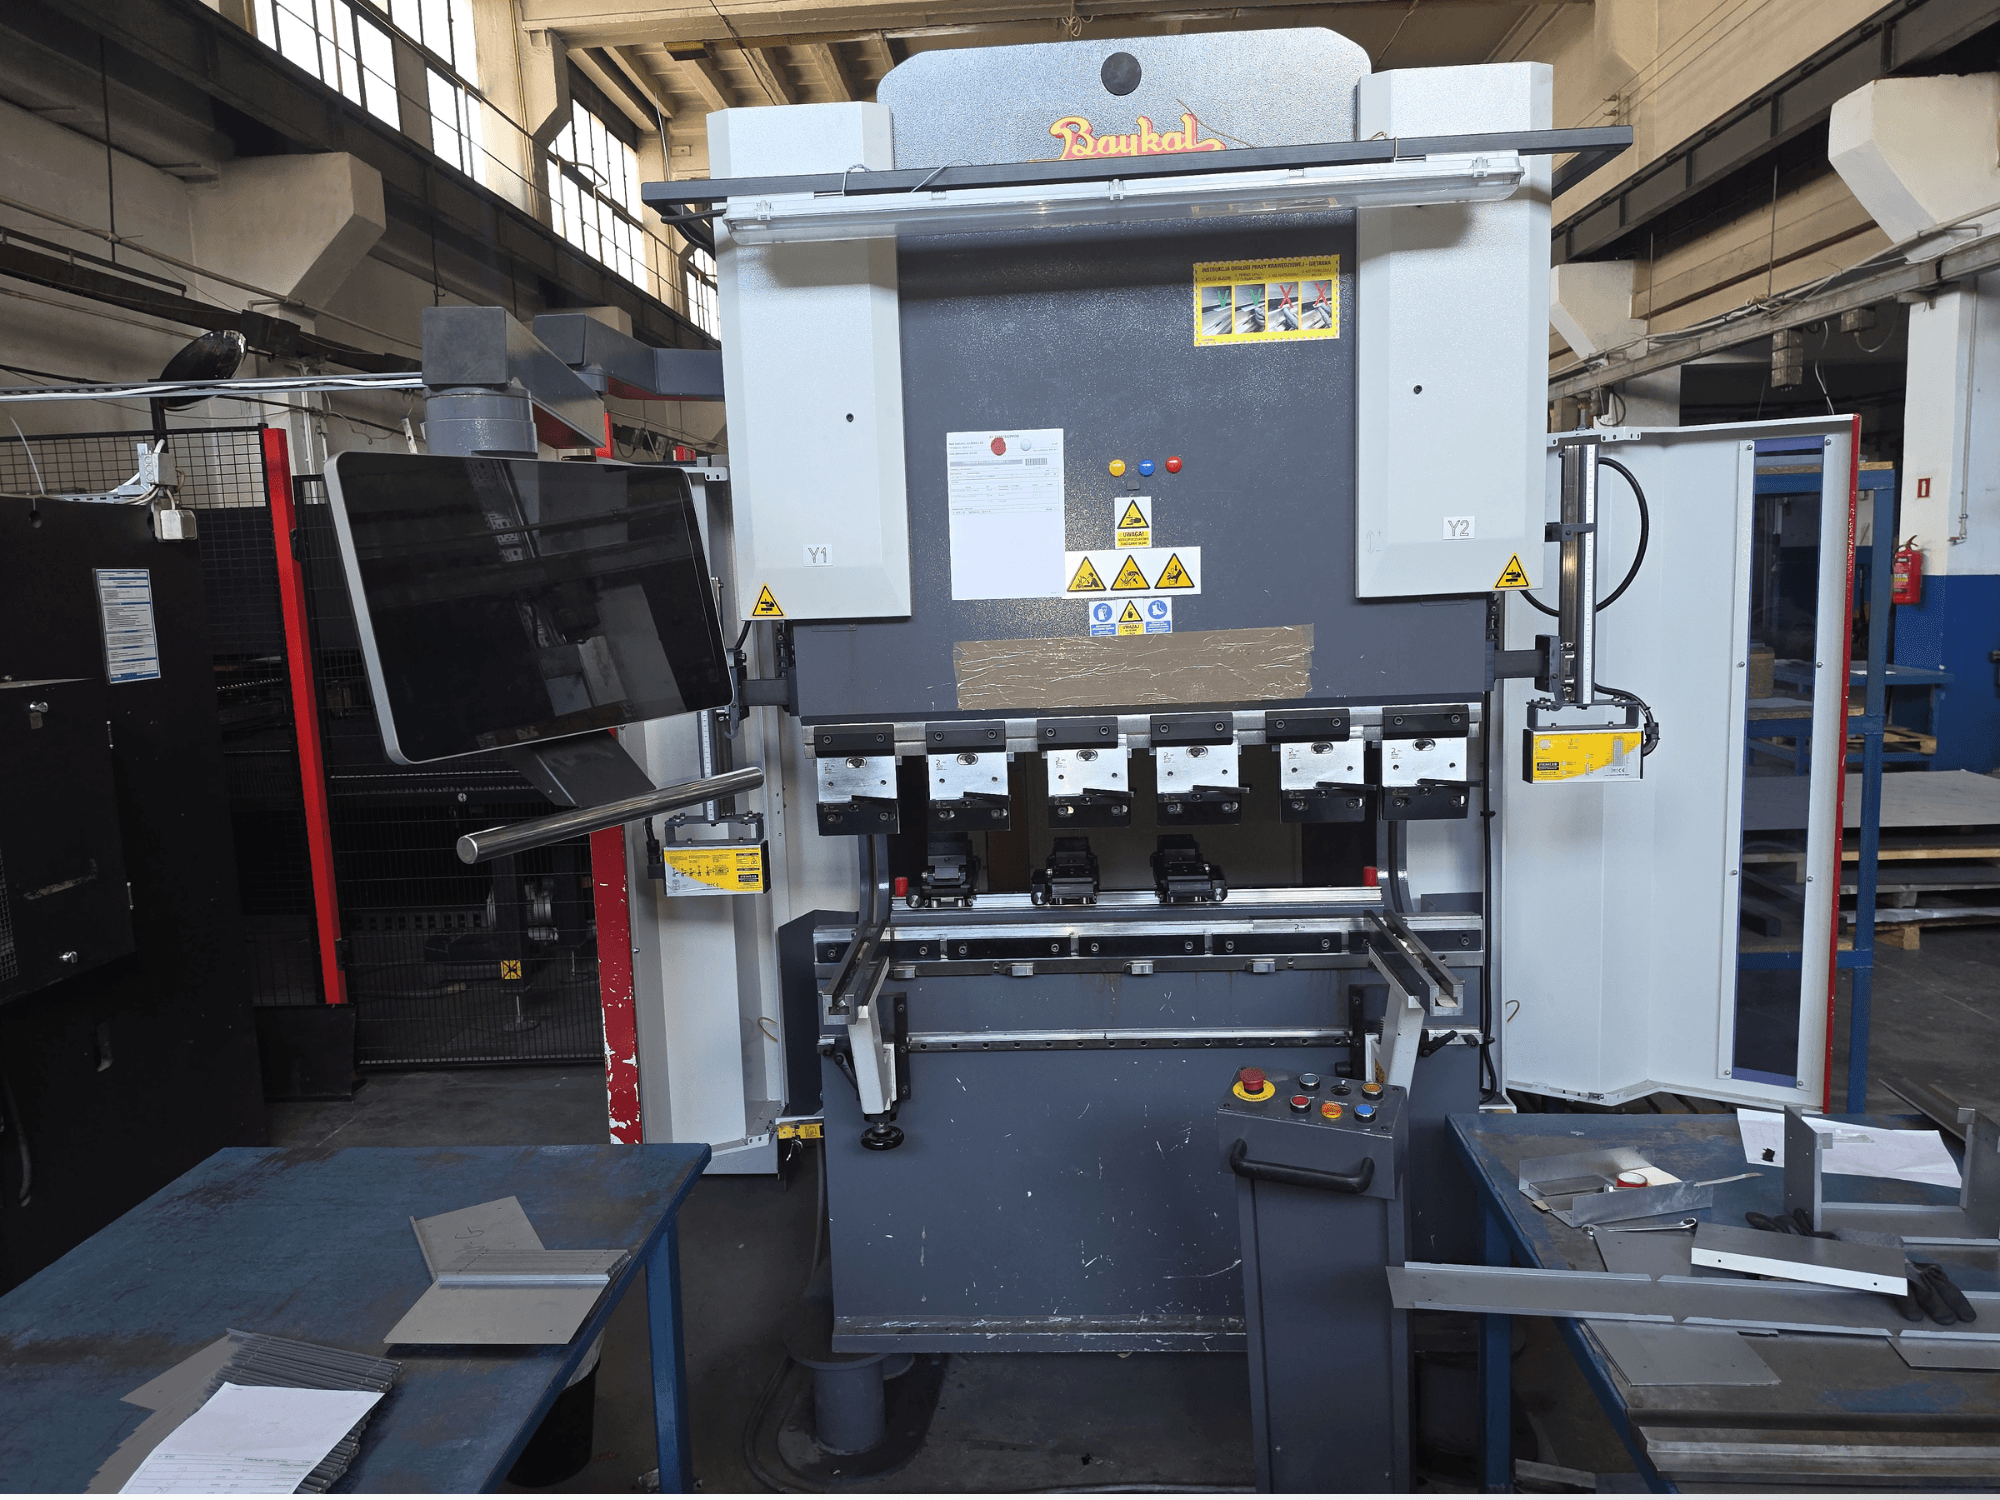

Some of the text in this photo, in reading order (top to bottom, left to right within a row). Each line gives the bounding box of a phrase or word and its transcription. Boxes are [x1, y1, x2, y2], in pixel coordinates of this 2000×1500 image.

[1049, 113, 1226, 159] Baykal
[1447, 519, 1470, 537] Y2
[807, 547, 827, 564] Y1
